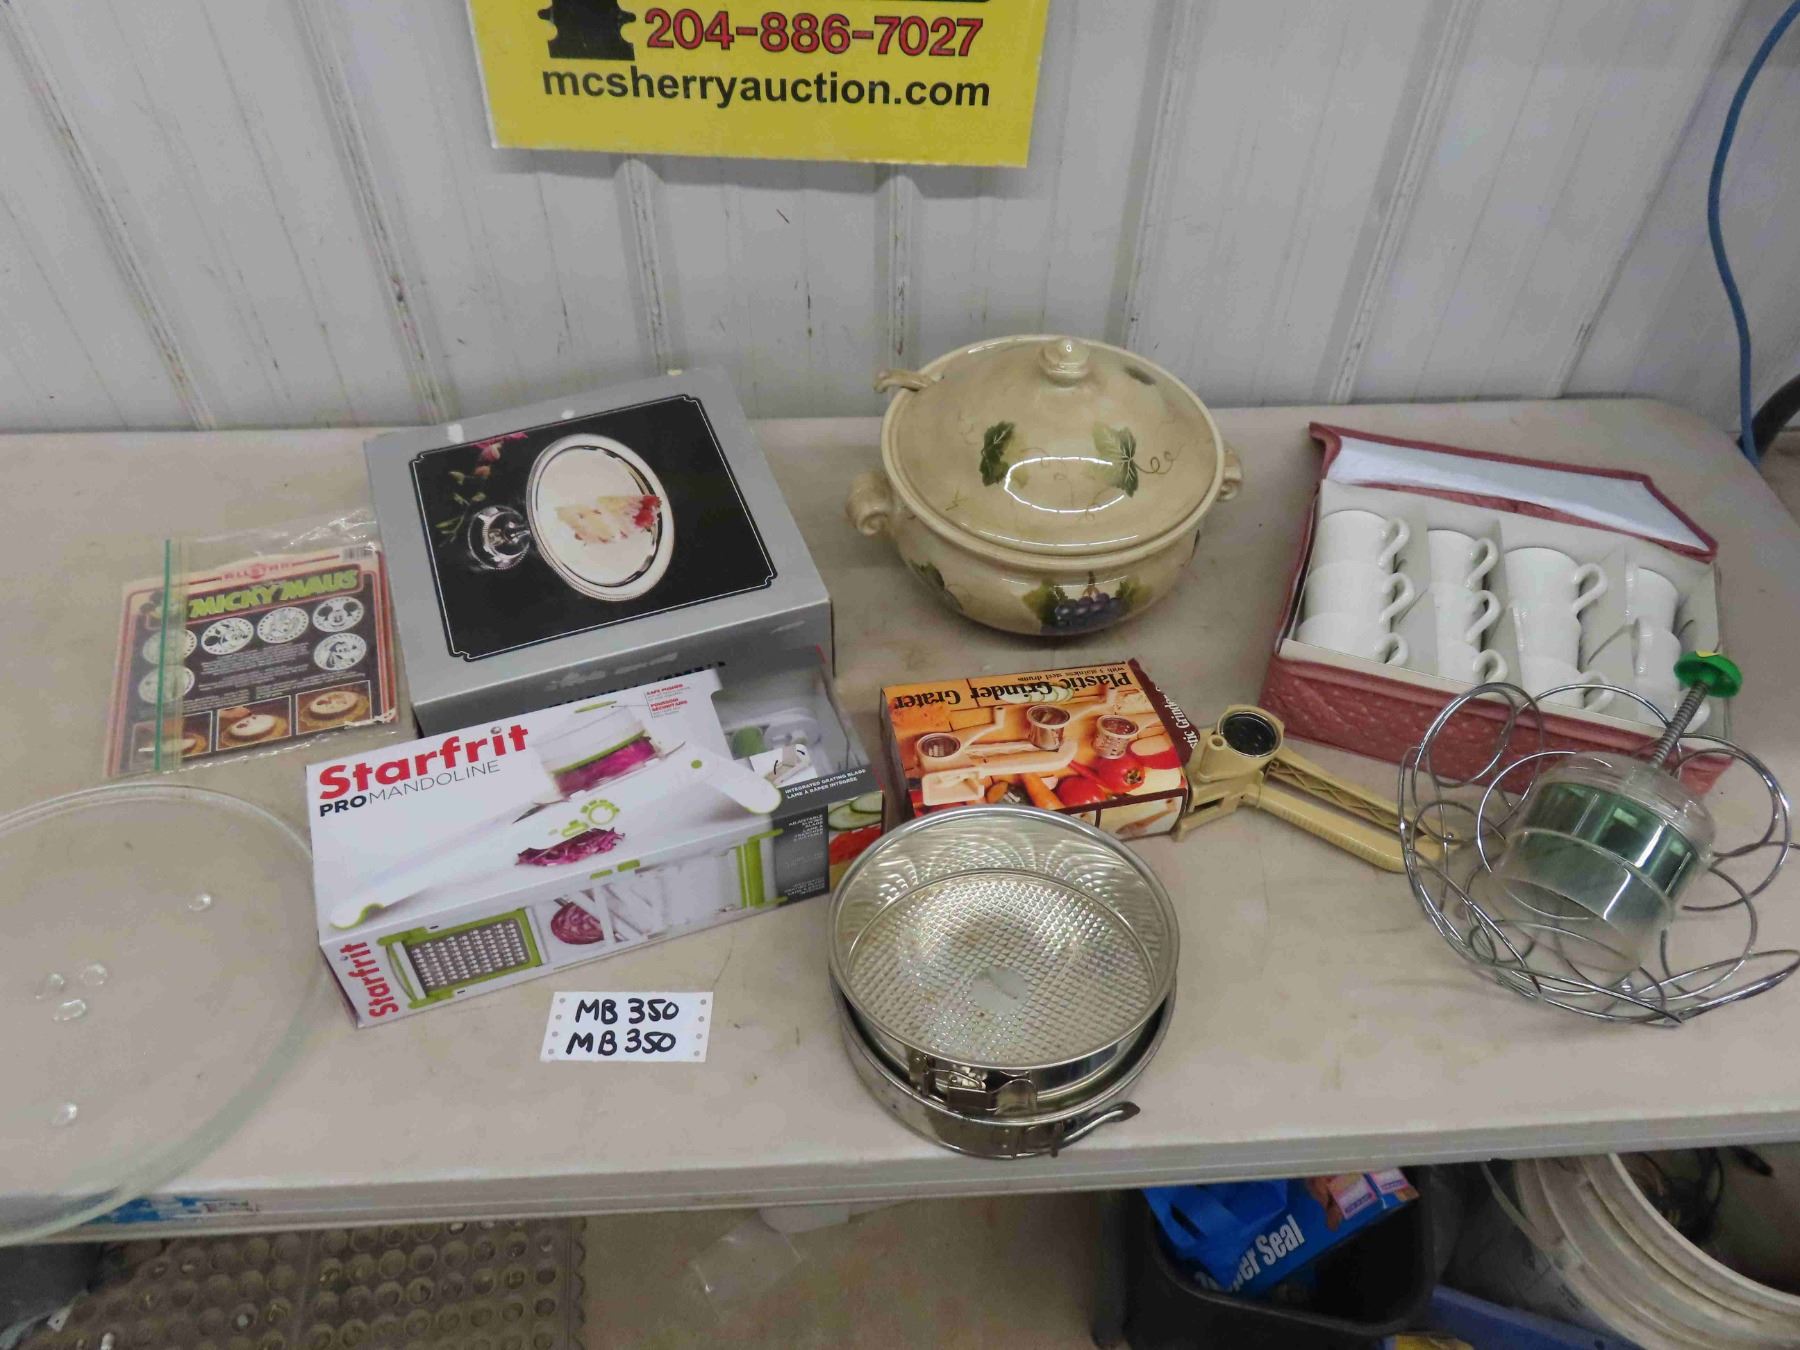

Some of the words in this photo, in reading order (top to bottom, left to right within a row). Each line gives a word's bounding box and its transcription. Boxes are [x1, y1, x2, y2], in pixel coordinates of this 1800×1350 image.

[645, 7, 983, 57] 204-886-7027
[542, 67, 990, 109] mcsherryauction.com
[189, 584, 279, 618] MICKY
[281, 570, 359, 600] MAUS
[894, 689, 961, 710] Grater
[969, 681, 1053, 700] Grinder
[1058, 672, 1132, 692] Plastic
[319, 724, 528, 800] Starfrit
[785, 781, 821, 794] INTEGRATED
[821, 774, 847, 785] GRATING
[847, 768, 866, 777] BLADE
[340, 941, 399, 1018] Starfrit
[575, 998, 618, 1025] MB
[627, 997, 680, 1025] 350
[566, 1030, 618, 1056] MB
[625, 1028, 677, 1054] 350
[1254, 1213, 1305, 1266] Seal
